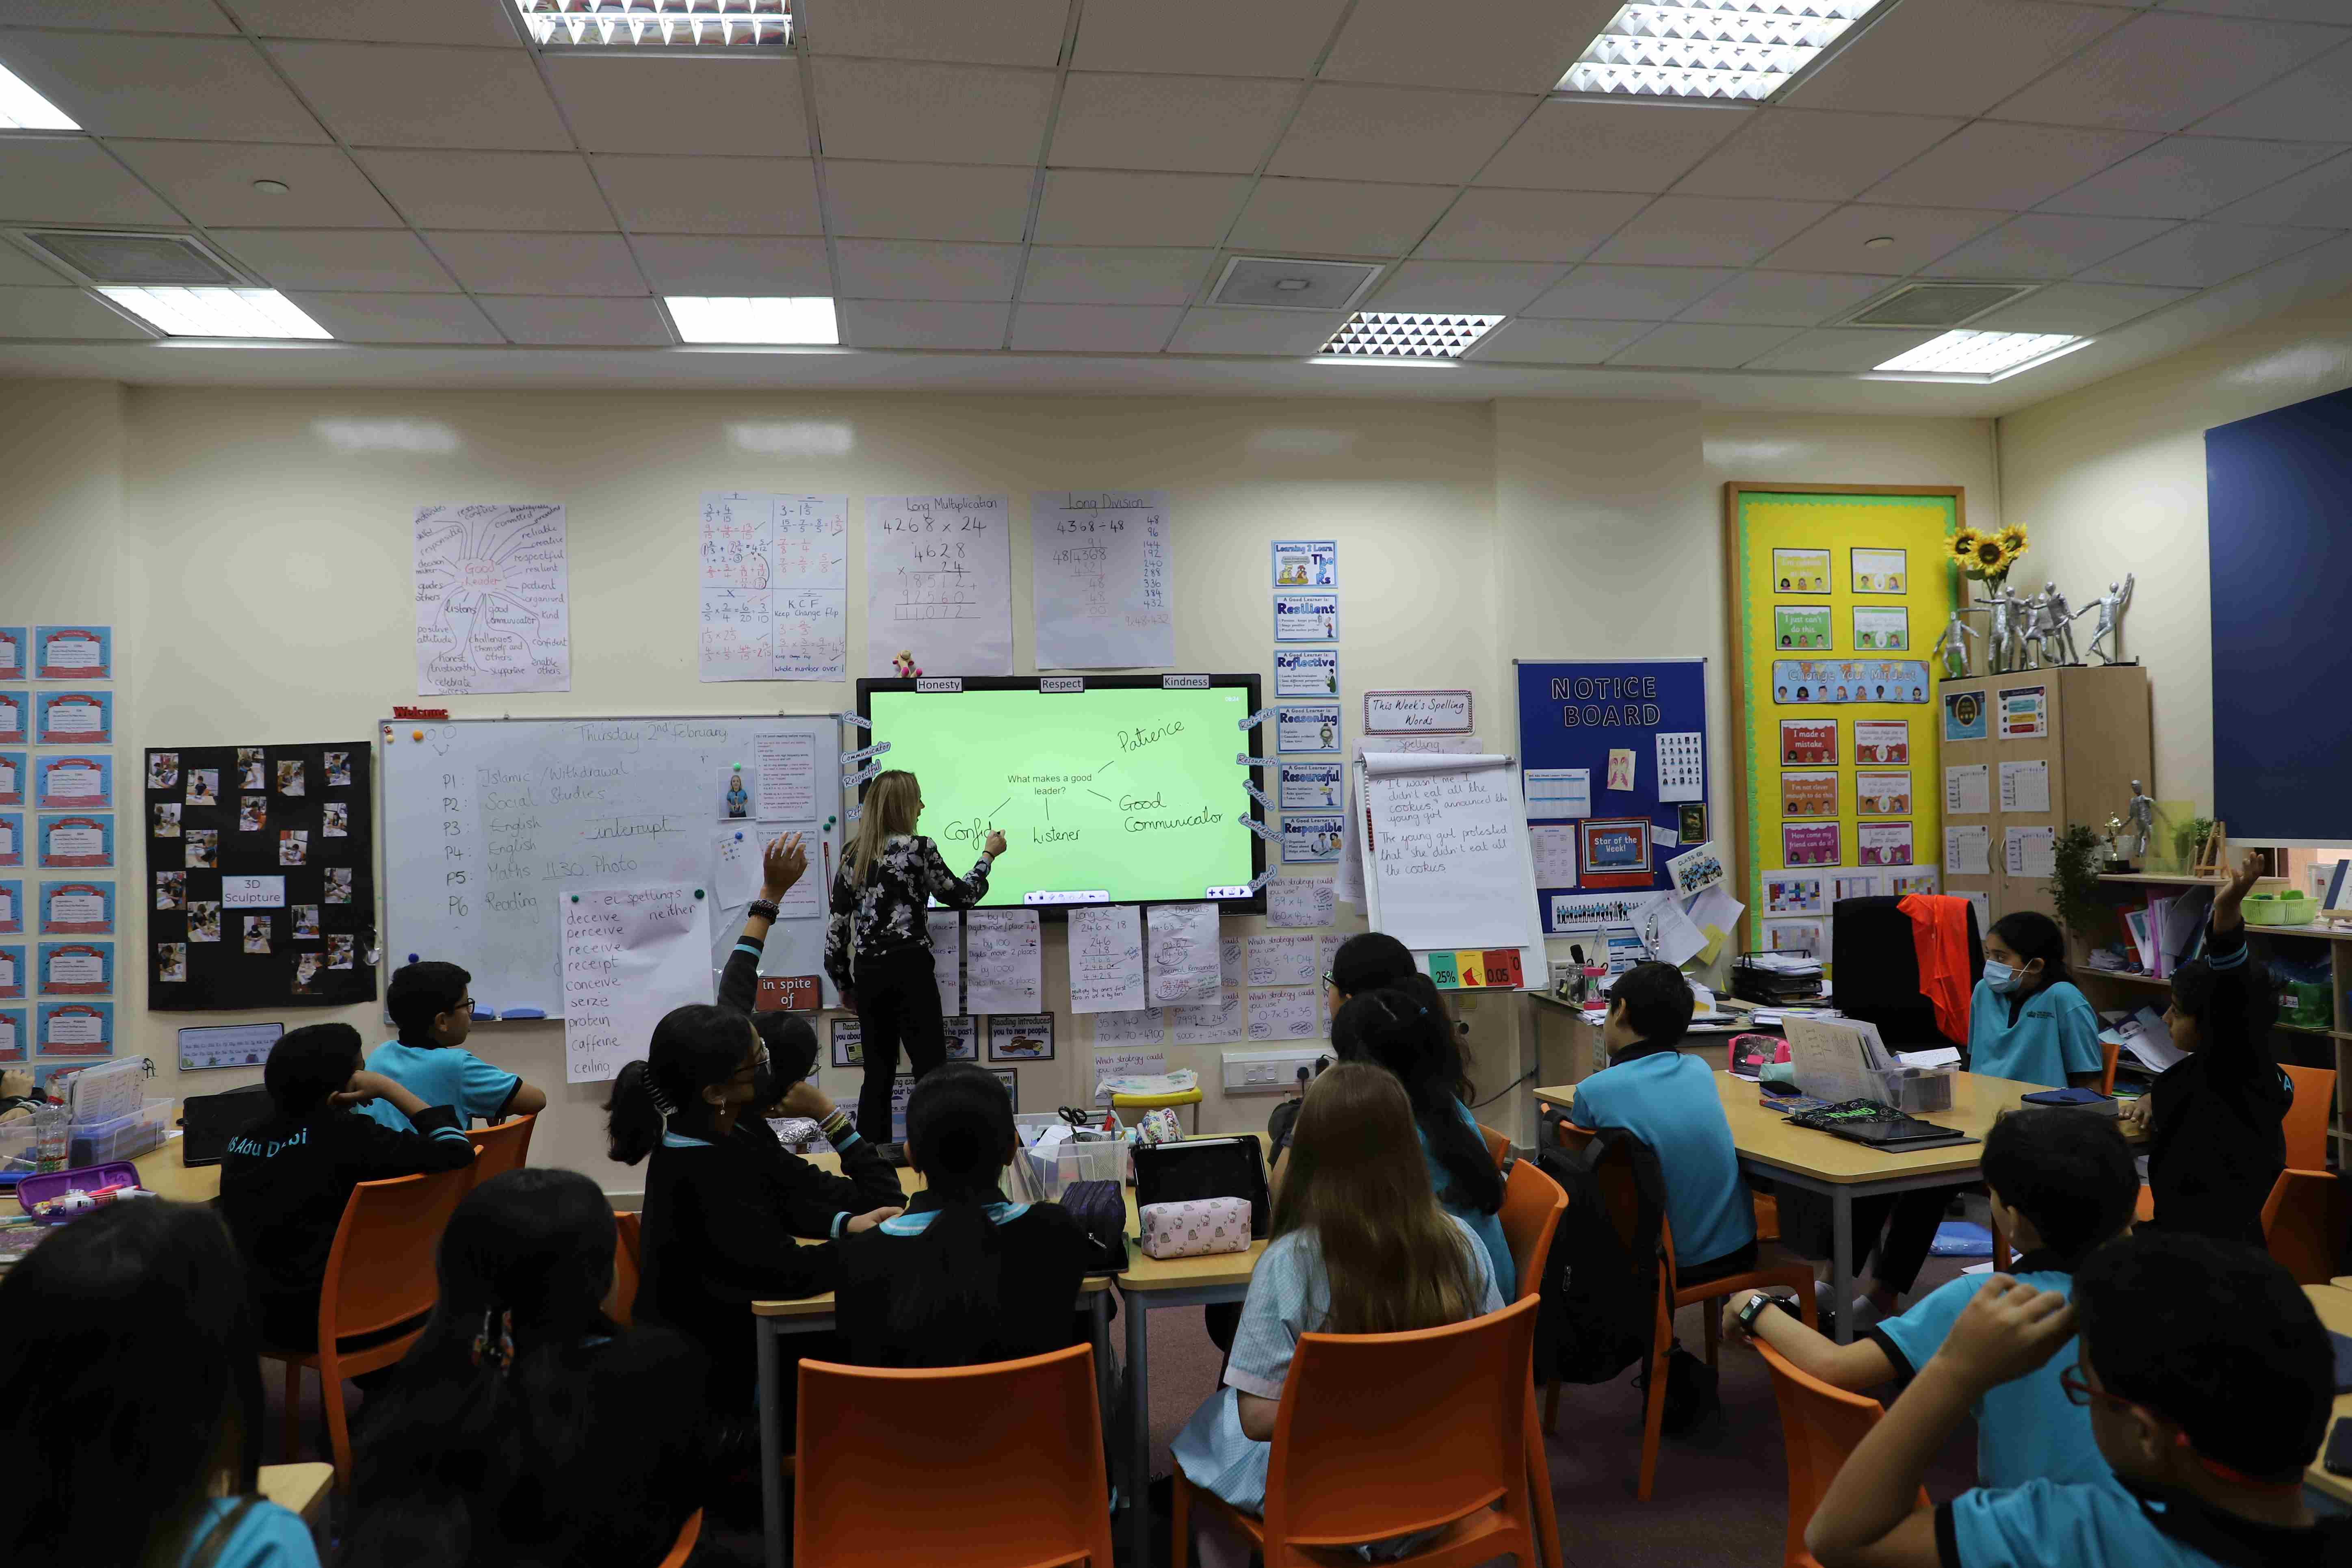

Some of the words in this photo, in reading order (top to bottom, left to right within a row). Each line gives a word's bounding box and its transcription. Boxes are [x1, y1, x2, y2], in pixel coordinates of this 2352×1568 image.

[907, 498, 929, 519] Long
[934, 496, 997, 513] Multiplication
[1069, 492, 1098, 518] Long
[1102, 493, 1143, 508] Division
[1147, 515, 1160, 524] 48
[522, 525, 557, 539] reliable
[1057, 520, 1094, 534] 4368
[1110, 521, 1124, 534] 48
[1147, 527, 1159, 537] 96
[1276, 544, 1306, 554] Learning
[515, 551, 564, 562] respectful
[1311, 554, 1334, 565] The
[465, 563, 495, 573] Good
[1316, 574, 1331, 585] Rs
[775, 611, 790, 619] Keep
[795, 610, 821, 621] Change
[825, 607, 838, 618] Flip
[1278, 603, 1335, 614] Resilient
[1790, 616, 1803, 624] just
[439, 653, 465, 662] honest
[1278, 657, 1335, 670] Reflective
[1165, 677, 1208, 687] Kindness
[1789, 669, 1835, 683] Change
[1871, 669, 1917, 682] Mindset
[918, 679, 960, 690] Honesty
[1042, 679, 1082, 690] Respect
[1551, 676, 1657, 700] NOTICE
[394, 706, 448, 719] Welcome
[1374, 700, 1392, 710] This
[1396, 699, 1425, 709] Week's
[1428, 699, 1464, 714] Spelling
[844, 711, 871, 727] Curious
[1241, 709, 1276, 729] Risk-Taker
[1280, 713, 1337, 726] Reasoning
[1406, 714, 1433, 725] Words
[1564, 704, 1660, 727] BOARD
[574, 723, 640, 754] Thursday
[673, 723, 728, 749] February
[1118, 721, 1184, 753] Patience
[842, 744, 889, 762] Communicator
[1399, 739, 1439, 753] Spelling
[1238, 755, 1278, 765] Resourceful
[844, 761, 880, 786] Respectful
[1008, 774, 1031, 782] What
[1033, 774, 1061, 782] makes
[1070, 773, 1092, 784] good
[1282, 770, 1339, 786] Resourceful
[1406, 775, 1436, 787] wasn't
[1034, 786, 1066, 795] leader?
[1244, 780, 1273, 810] Empathetic
[1389, 790, 1419, 801] didn't
[1424, 786, 1441, 797] eat
[1448, 785, 1462, 794] all
[1469, 782, 1486, 793] the
[485, 788, 538, 810] Social
[549, 789, 606, 804] Studies
[1119, 797, 1166, 812] Good
[1445, 795, 1490, 808] announced
[489, 815, 542, 834] English
[1124, 813, 1223, 833] Communicator
[1388, 813, 1419, 827] young
[594, 816, 674, 841] interrupt
[1033, 825, 1081, 843] Listener
[1241, 813, 1284, 842] Knowledgeable
[1285, 823, 1342, 836] Responsible
[1379, 832, 1395, 844] The
[1401, 833, 1432, 850] young
[1463, 824, 1507, 841] protested
[488, 840, 537, 864] English
[1380, 848, 1402, 860] that
[1412, 847, 1428, 858] she
[1433, 844, 1466, 857] didn't
[1470, 842, 1488, 851] eat
[1606, 844, 1626, 853] Week!
[1789, 841, 1806, 849] friend
[592, 855, 637, 875] Photo
[1678, 855, 1695, 866] CLASS
[487, 863, 531, 881] Maths
[1386, 864, 1400, 876] the
[245, 879, 260, 889] 3D
[1250, 866, 1276, 890] Resilient
[1267, 879, 1285, 888] Which
[1288, 878, 1314, 889] strategy
[225, 893, 280, 903] Sculpture
[627, 889, 682, 906] spellings
[484, 892, 538, 924] Reading
[650, 904, 695, 920] neither
[567, 910, 620, 925] deceive
[1076, 911, 1095, 923] Long
[567, 926, 624, 942] perceive
[569, 943, 624, 955] receive
[1268, 938, 1294, 946] strategy
[568, 956, 618, 974] receipt
[1436, 971, 1455, 983] 25%
[1487, 969, 1508, 982] 0.05
[566, 977, 622, 991] conceive
[763, 979, 775, 990] in
[780, 979, 811, 992] spite
[571, 997, 609, 1007] seize
[781, 993, 794, 1008] of
[1270, 992, 1295, 1001] strategy
[568, 1015, 610, 1033] protein
[992, 1018, 1016, 1027] Reading
[994, 1027, 1005, 1036] you
[1028, 1026, 1049, 1035] people.
[572, 1035, 621, 1052] caffeine
[574, 1059, 610, 1079] ceiling
